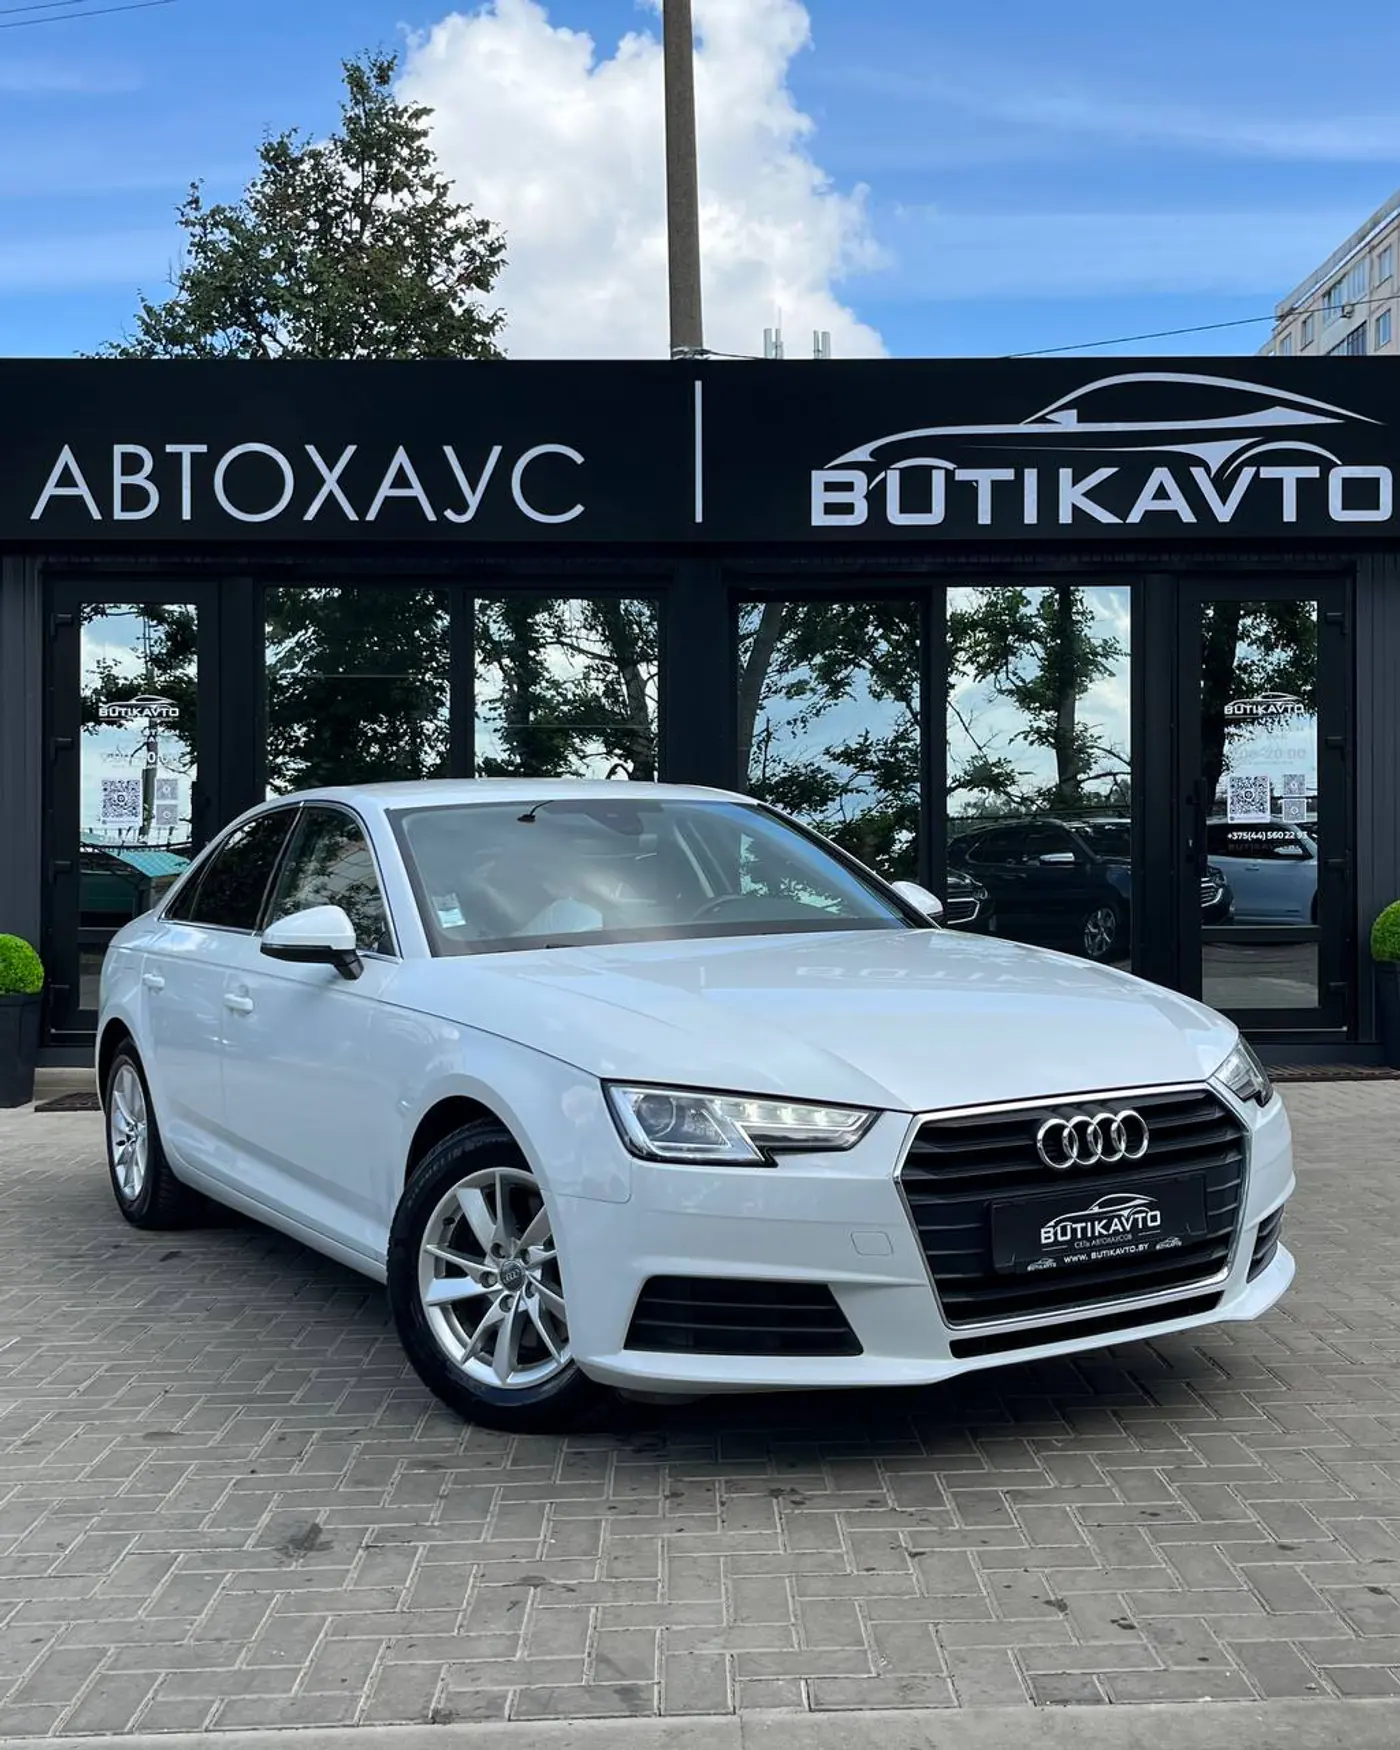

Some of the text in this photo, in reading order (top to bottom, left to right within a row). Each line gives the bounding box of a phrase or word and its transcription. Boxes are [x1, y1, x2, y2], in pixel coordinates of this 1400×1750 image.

[30, 442, 585, 524] АВТОХАУС
[811, 464, 1394, 526] BUTIKAVTO
[99, 707, 179, 717] BUTIKAVTO
[1224, 704, 1304, 715] BUTIKAVTO
[1227, 831, 1266, 841] +375(44)
[1267, 831, 1284, 840] 560
[1284, 831, 1296, 840] 22
[1040, 1210, 1161, 1244] BUTIKAVTO
[1091, 1243, 1150, 1260] BUTIKAVTO.BY
